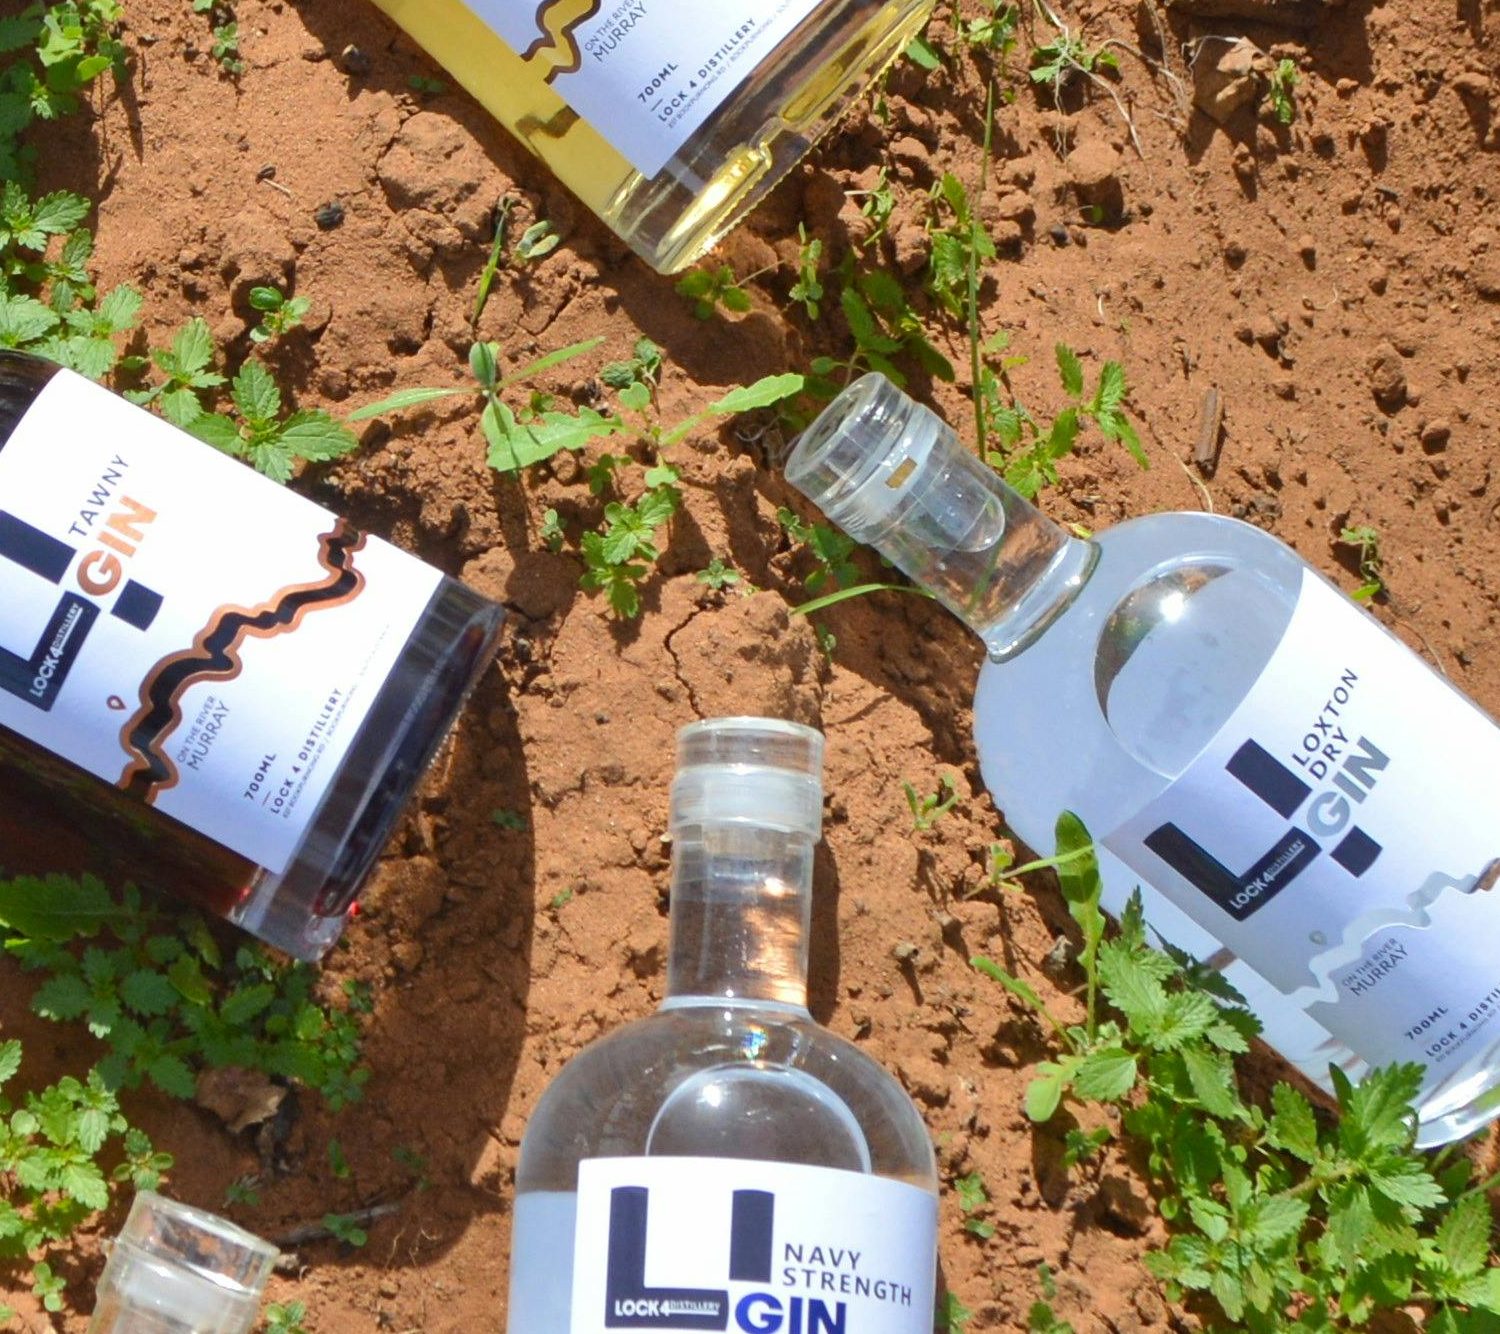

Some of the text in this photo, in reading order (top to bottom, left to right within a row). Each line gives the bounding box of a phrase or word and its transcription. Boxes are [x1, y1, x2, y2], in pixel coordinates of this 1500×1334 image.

[582, 33, 600, 52] ON
[595, 18, 614, 37] THE
[590, 0, 650, 63] MURRAY
[636, 59, 679, 104] 700ML
[656, 16, 758, 122] LOCK 4 DISTILLERY
[67, 453, 131, 541] TAWNY
[68, 492, 158, 604] GIN
[51, 601, 80, 647] DISTILLERY
[175, 694, 217, 763] ON THE RIVER
[185, 699, 232, 771] MURRAY
[1290, 667, 1359, 767] LOXTON
[243, 749, 277, 801] 700ML
[268, 775, 295, 814] LOCK
[289, 763, 302, 775] 4
[297, 686, 343, 761] DISTILLERY
[1307, 726, 1352, 781] DRY
[1299, 734, 1393, 846] GIN
[1342, 935, 1399, 989] ON THE RIVER
[1350, 942, 1411, 998] MURRAY
[1405, 1003, 1449, 1042] 700ML
[1425, 1028, 1460, 1058] LOCK
[1457, 1020, 1469, 1032] 4
[784, 1242, 862, 1271] NAVY
[782, 1266, 911, 1307] STRENGTH
